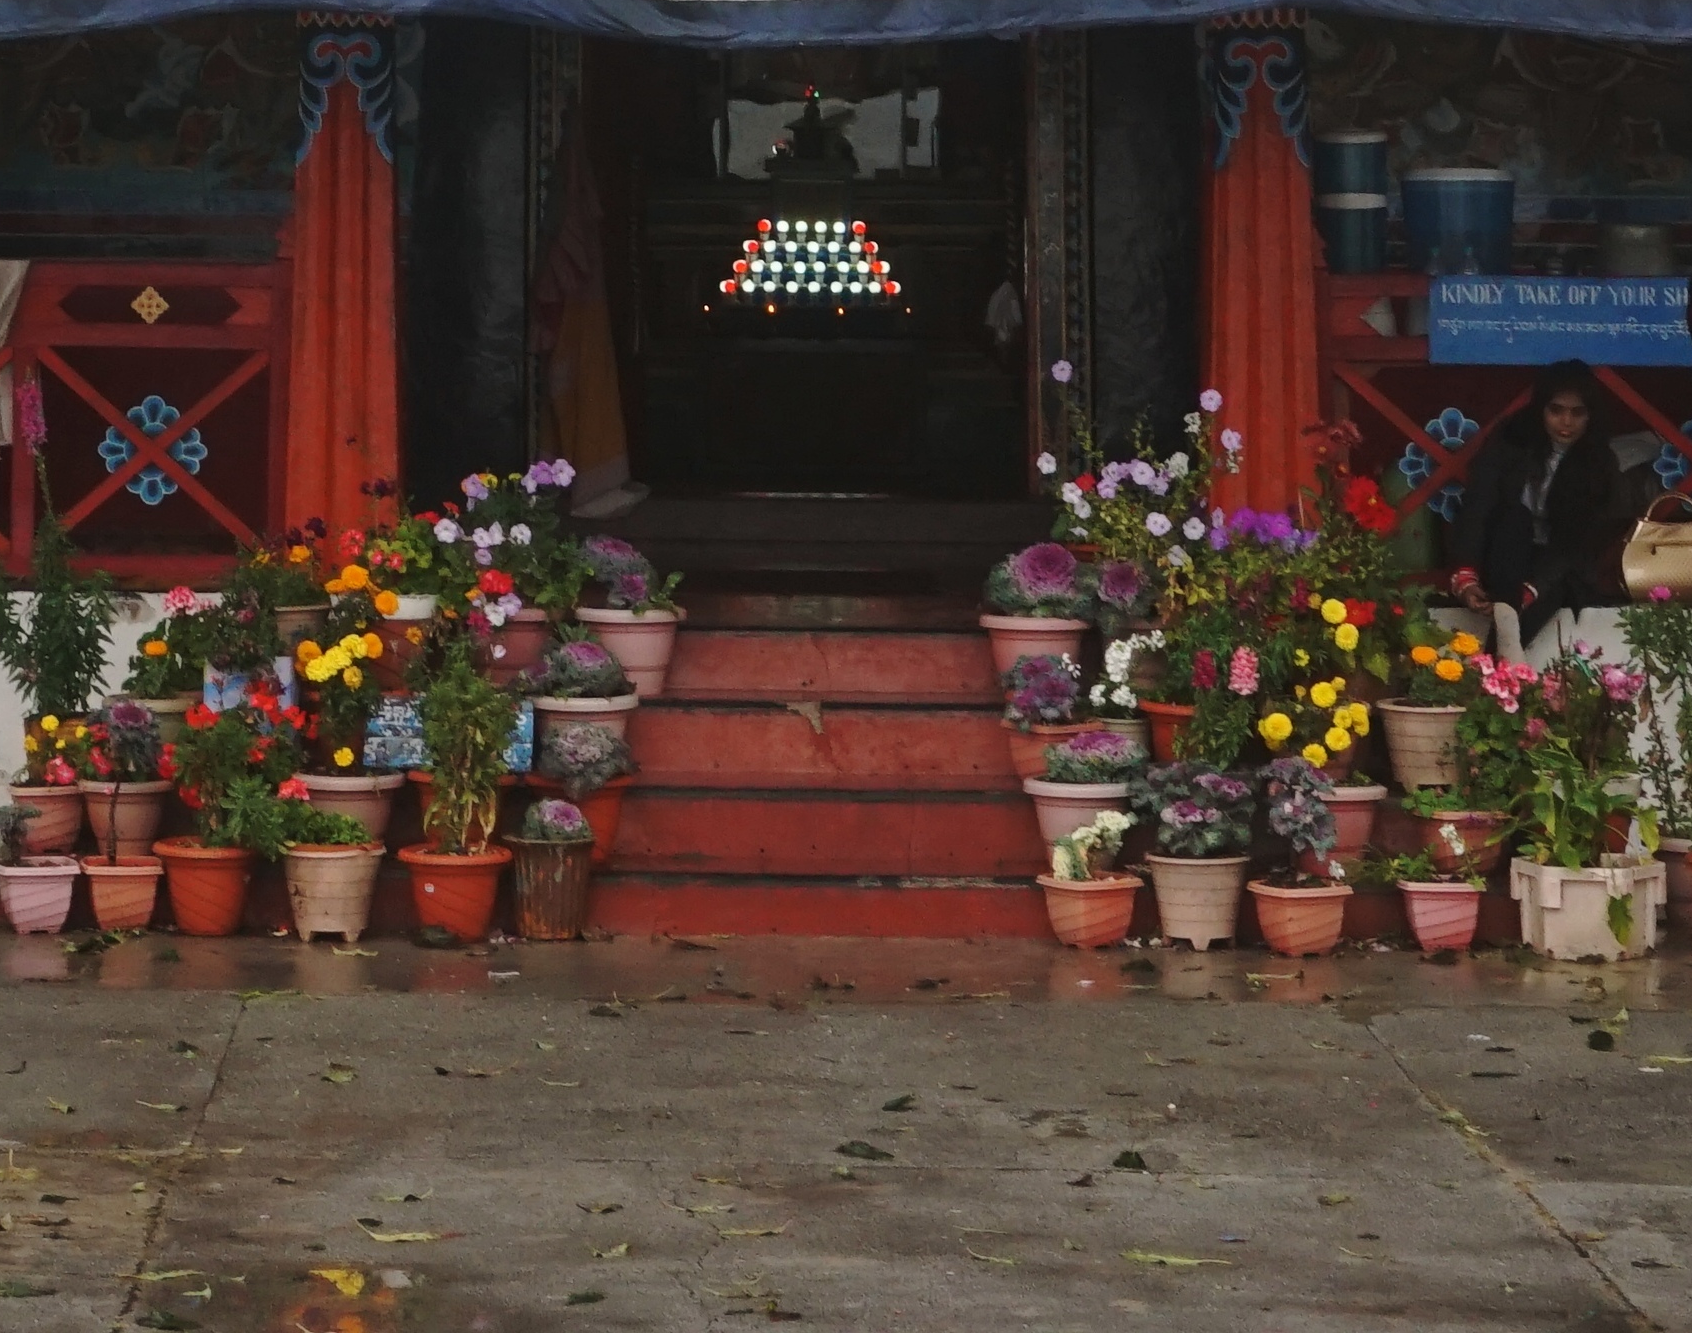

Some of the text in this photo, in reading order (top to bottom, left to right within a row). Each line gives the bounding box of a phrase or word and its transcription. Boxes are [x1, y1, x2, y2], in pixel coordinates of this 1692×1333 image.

[1441, 283, 1506, 304] KINDLY
[1514, 284, 1561, 305] TAKE
[1568, 285, 1602, 305] OFF
[1608, 285, 1657, 306] YOUR
